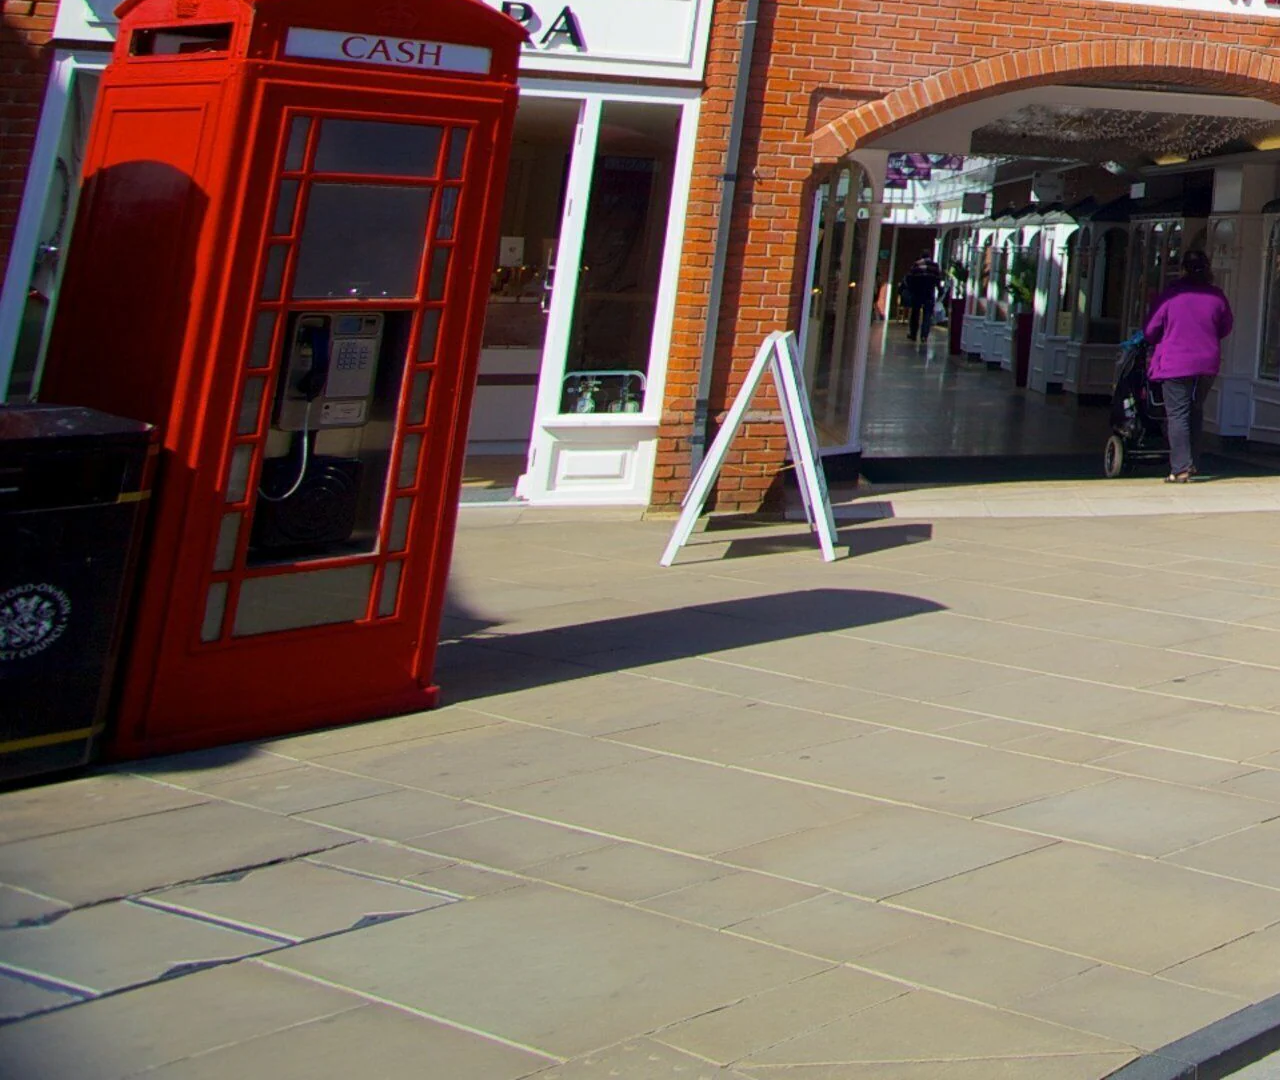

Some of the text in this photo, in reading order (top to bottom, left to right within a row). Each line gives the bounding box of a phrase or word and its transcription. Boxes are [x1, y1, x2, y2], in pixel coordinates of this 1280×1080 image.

[341, 34, 443, 67] CASH
[0, 583, 71, 614] FORD-ON-AVON
[19, 623, 68, 659] COUNCIL
